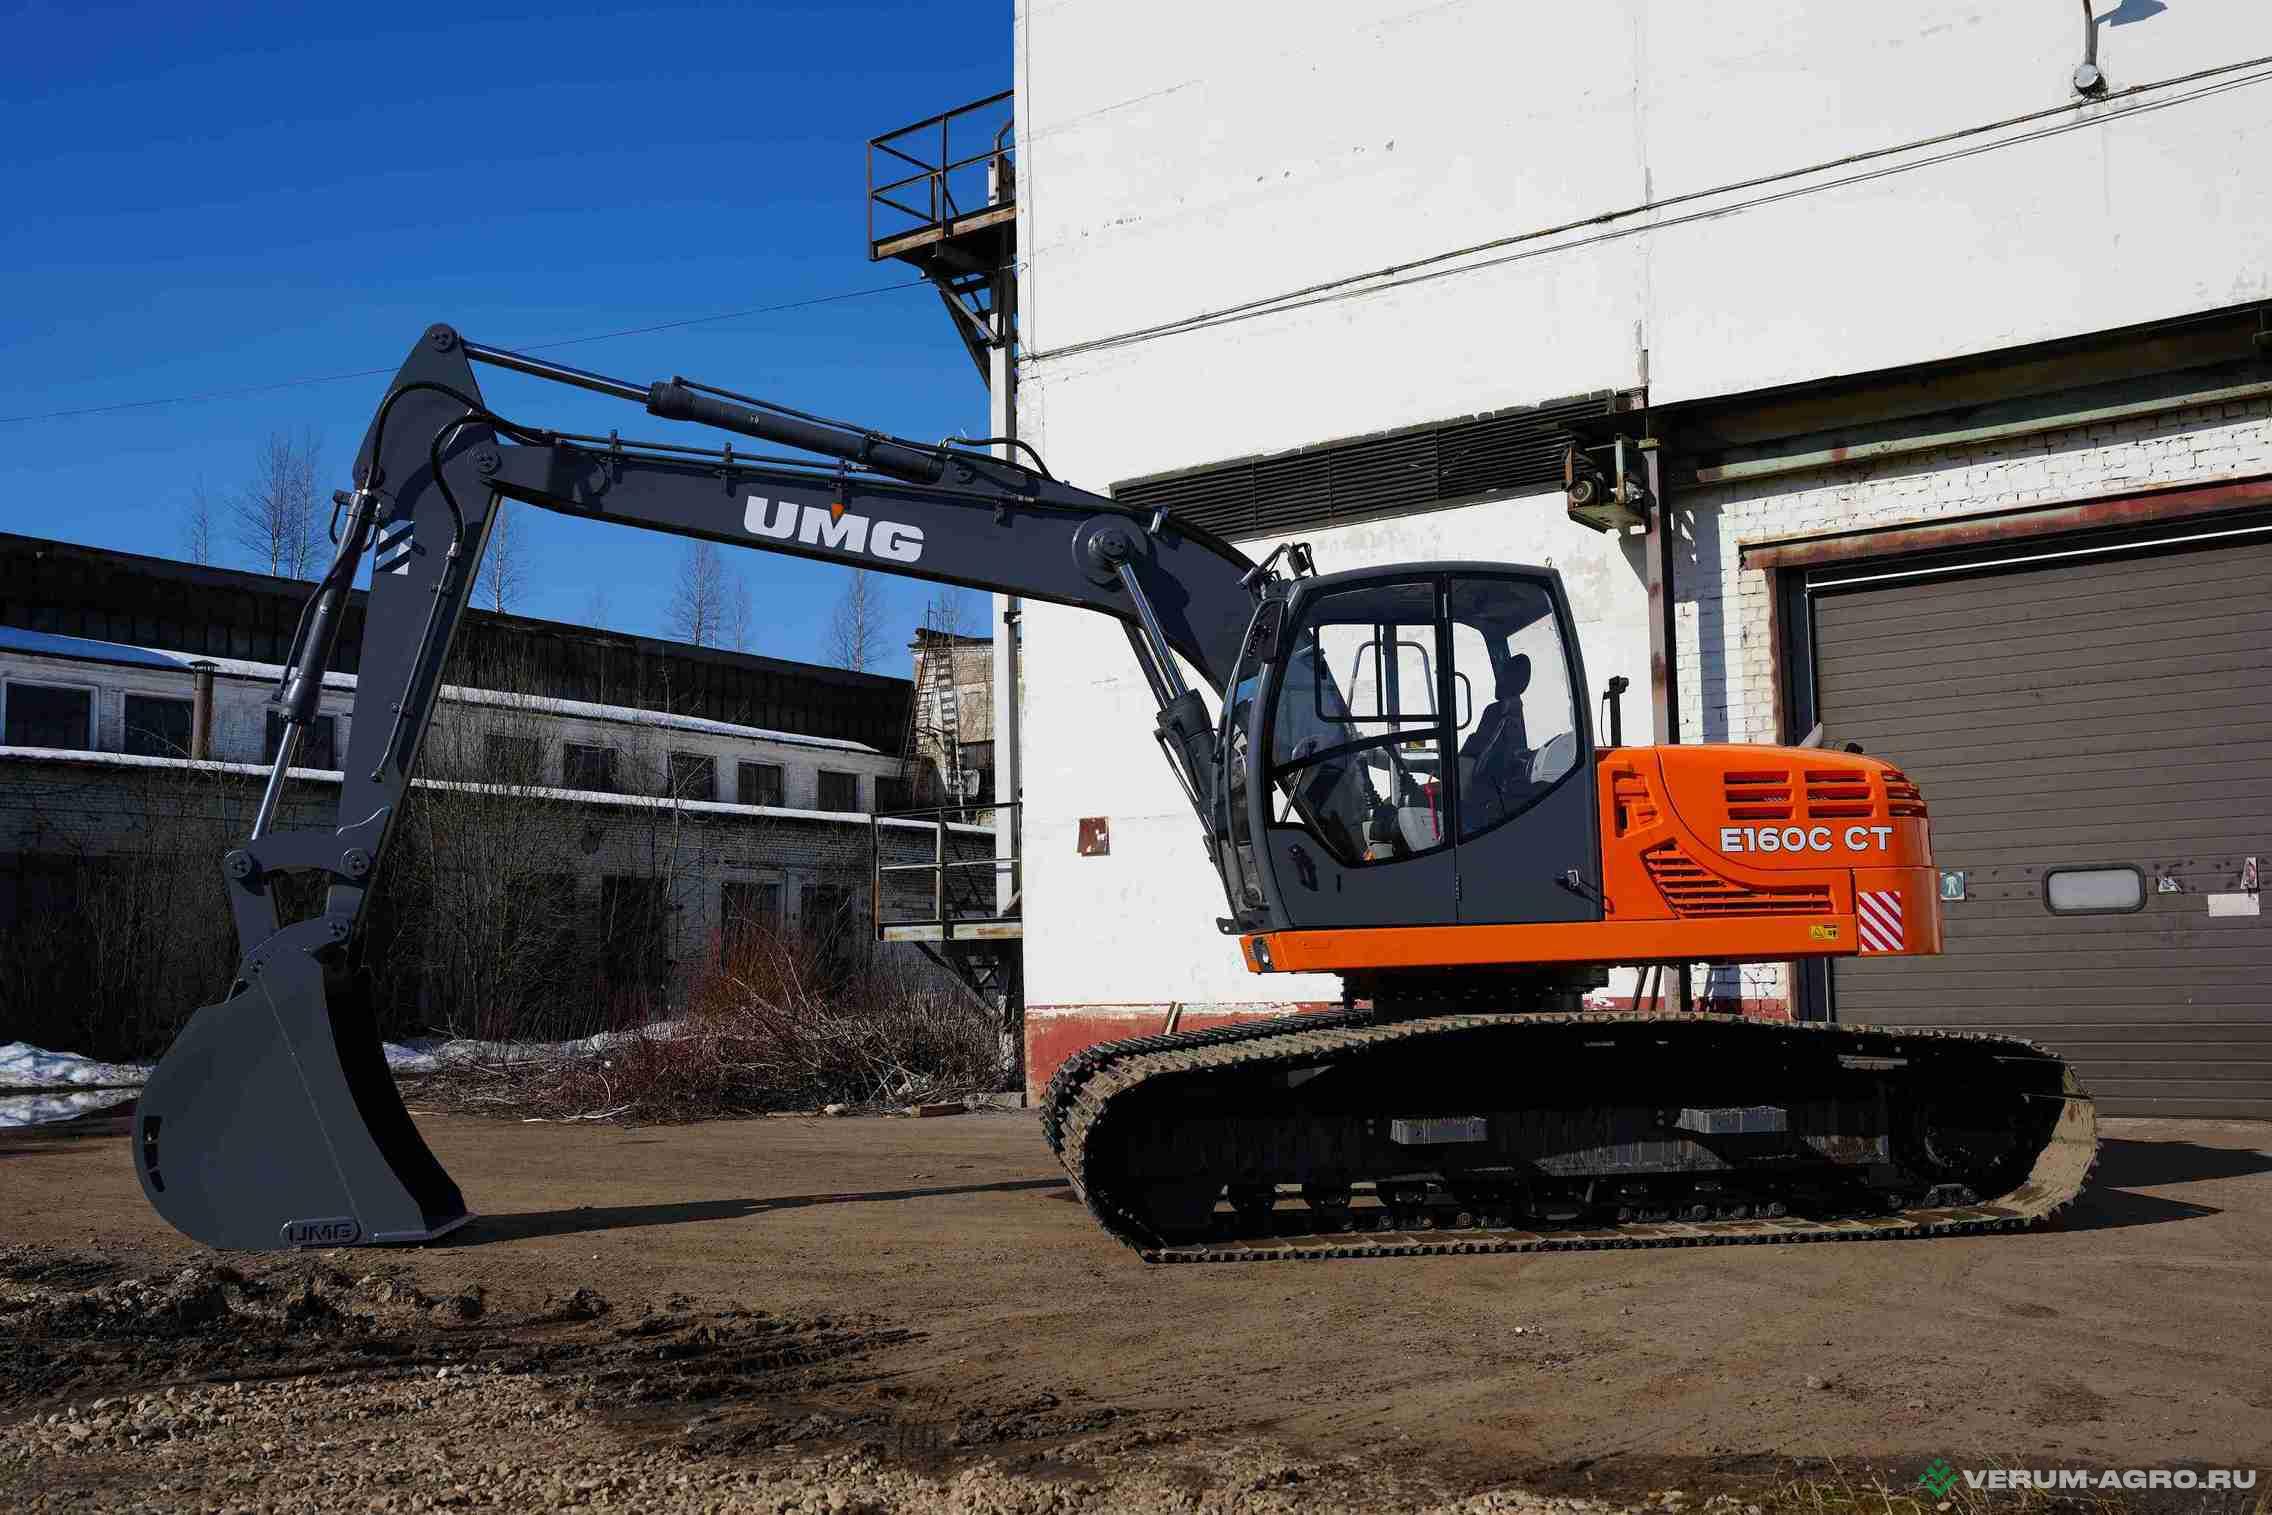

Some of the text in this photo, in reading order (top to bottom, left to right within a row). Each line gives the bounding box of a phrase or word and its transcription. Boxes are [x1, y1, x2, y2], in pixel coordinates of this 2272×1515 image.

[744, 495, 925, 563] UMG
[1720, 826, 1893, 852] E160C CT
[288, 1222, 354, 1242] UMG
